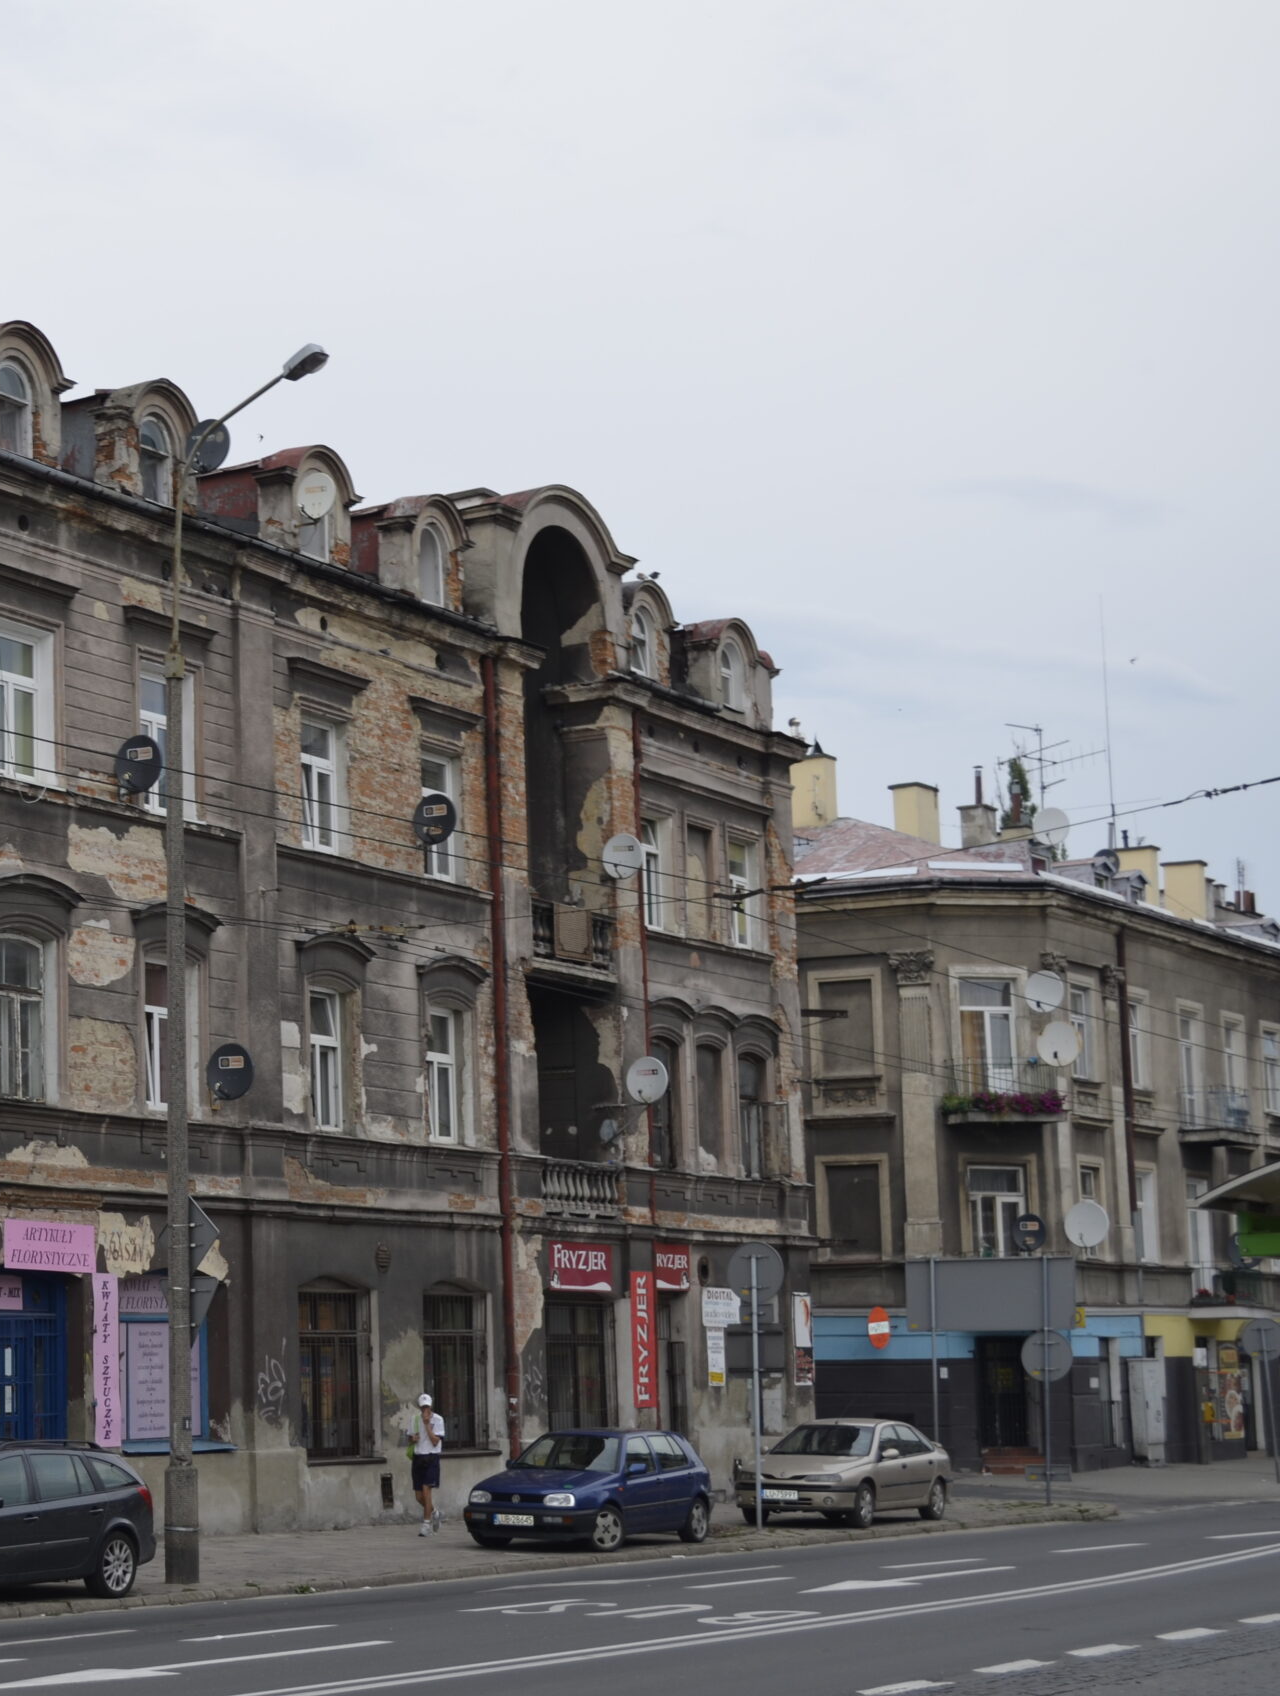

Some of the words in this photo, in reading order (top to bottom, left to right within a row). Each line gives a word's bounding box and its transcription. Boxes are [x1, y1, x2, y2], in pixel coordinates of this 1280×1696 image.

[23, 1226, 76, 1244] ARTYKUŁY
[10, 1248, 90, 1267] FLORYSTYCZNE
[553, 1244, 607, 1272] FRYZJER
[656, 1253, 688, 1270] RYZJER
[636, 1274, 649, 1402] FRYZJER
